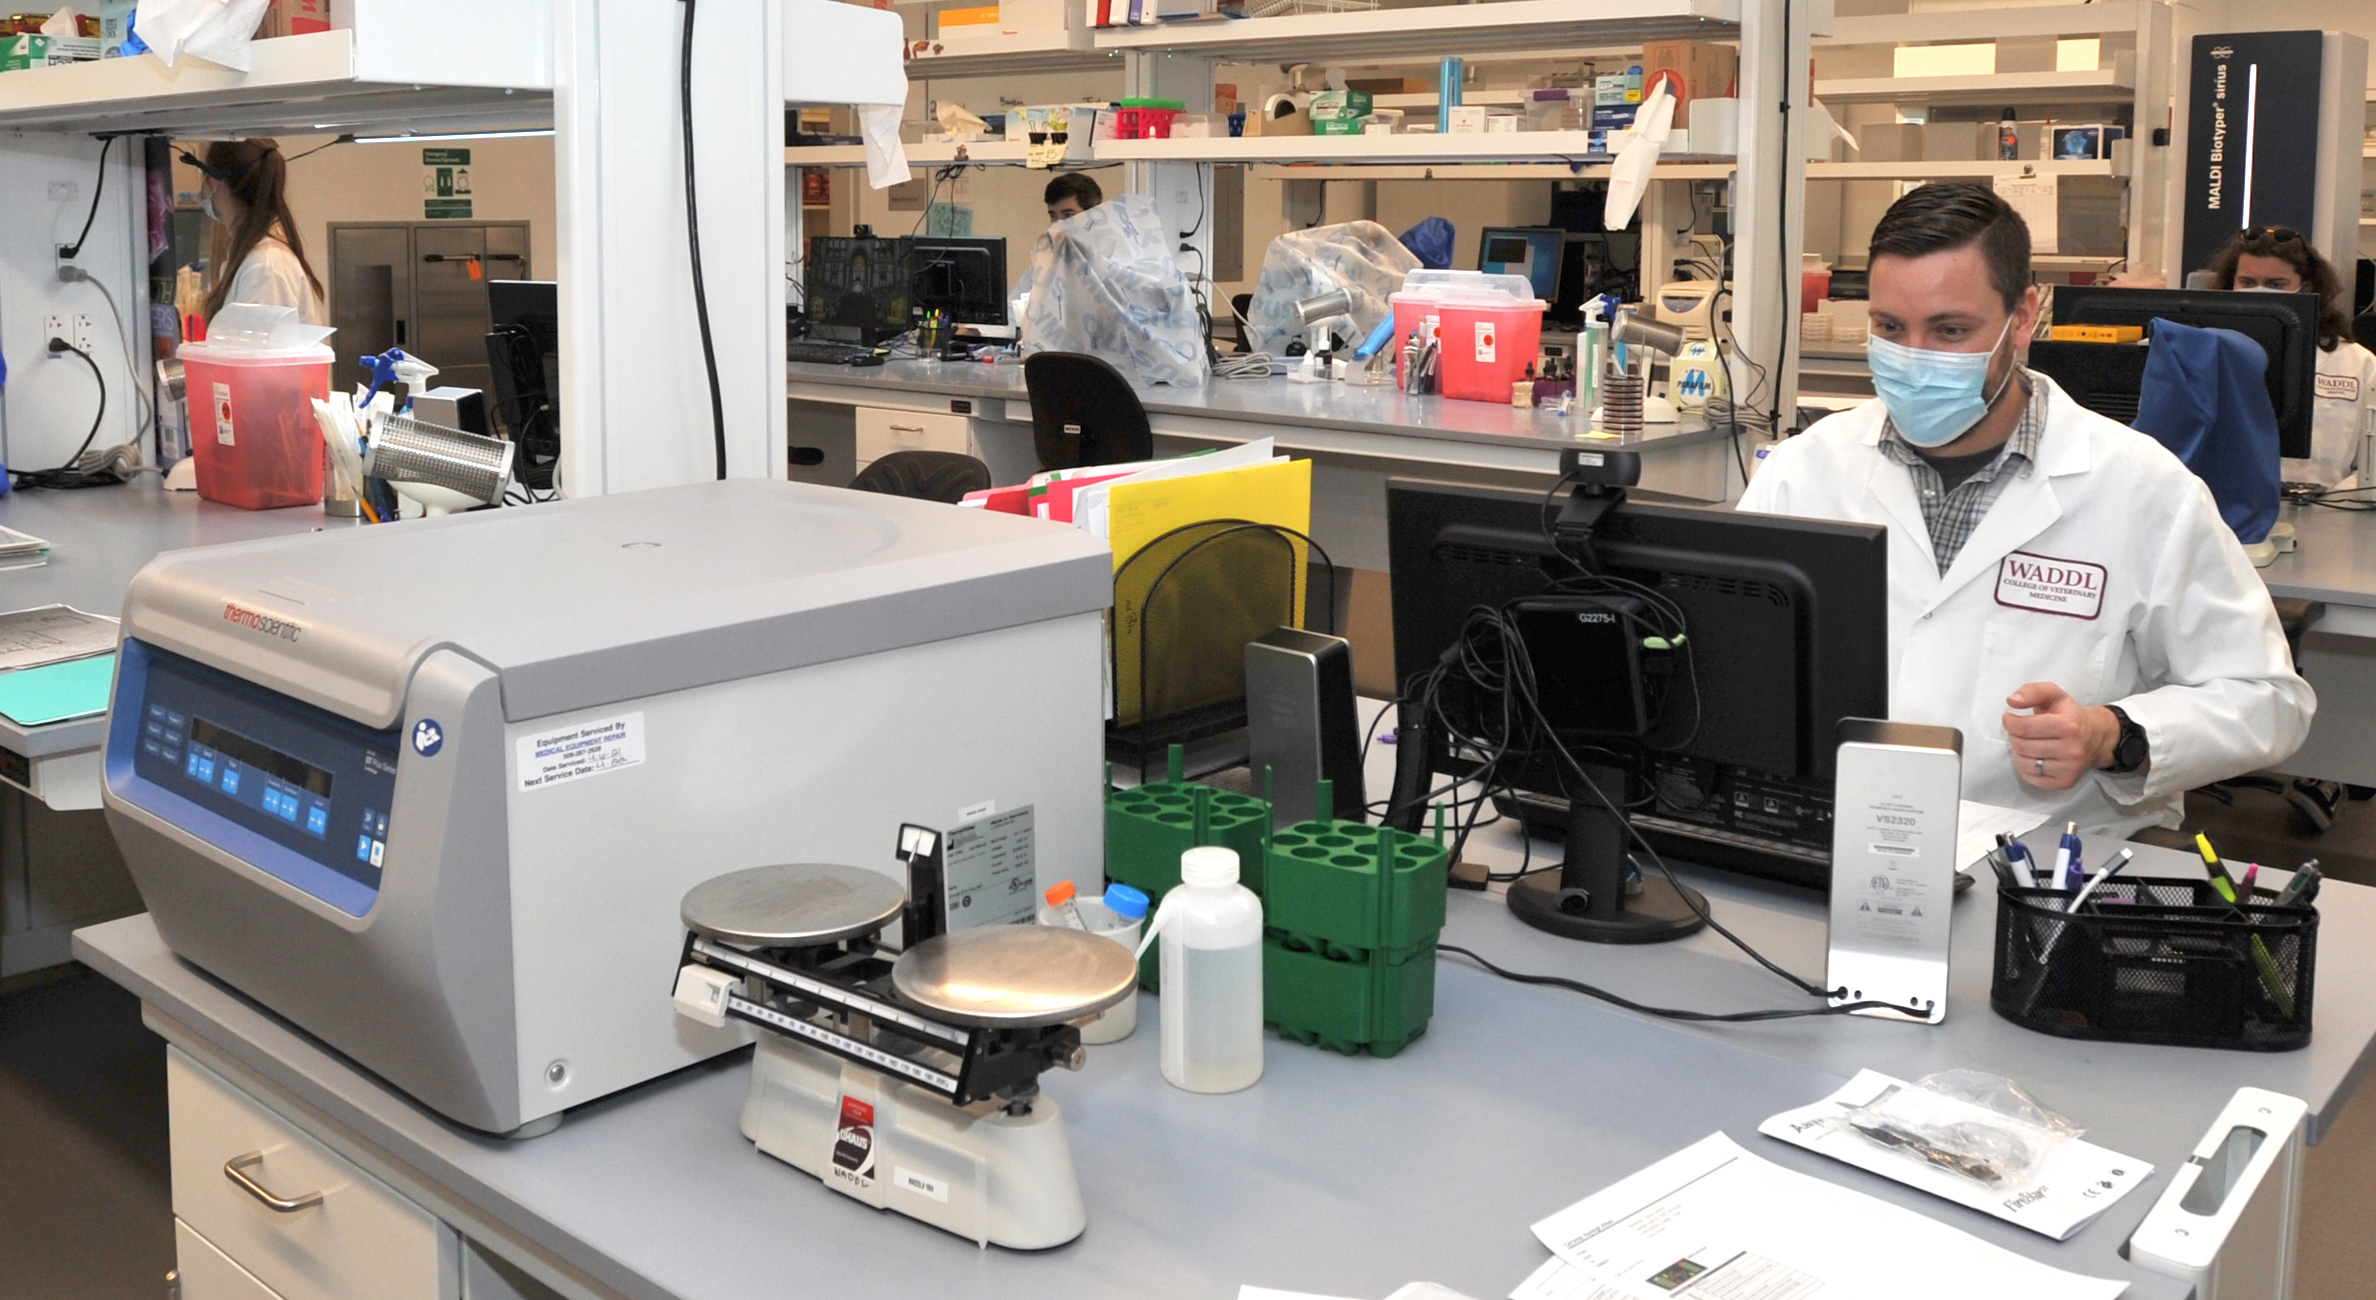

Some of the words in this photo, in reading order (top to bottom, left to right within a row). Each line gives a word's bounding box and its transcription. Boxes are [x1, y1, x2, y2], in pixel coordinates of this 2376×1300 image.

[2214, 64, 2227, 100] sirius
[2208, 165, 2222, 209] MALDI
[2317, 376, 2356, 389] WADDL
[2009, 560, 2098, 591] WADDL
[2003, 578, 2039, 591] COLLEGE
[2050, 586, 2097, 599] VETERINARY
[2029, 592, 2067, 603] MEDICINE
[535, 746, 564, 759] MEDICAL
[565, 737, 602, 752] EQUIPMENT
[603, 731, 626, 743] REPAIR
[536, 732, 578, 748] Equipment
[580, 724, 613, 738] Serviced
[615, 721, 625, 732] By
[524, 777, 542, 788] Next
[544, 770, 573, 783] Service
[575, 763, 595, 776] Date:
[542, 764, 557, 773] Date
[1876, 814, 1916, 827] VS2320
[840, 1129, 868, 1150] OHAUS
